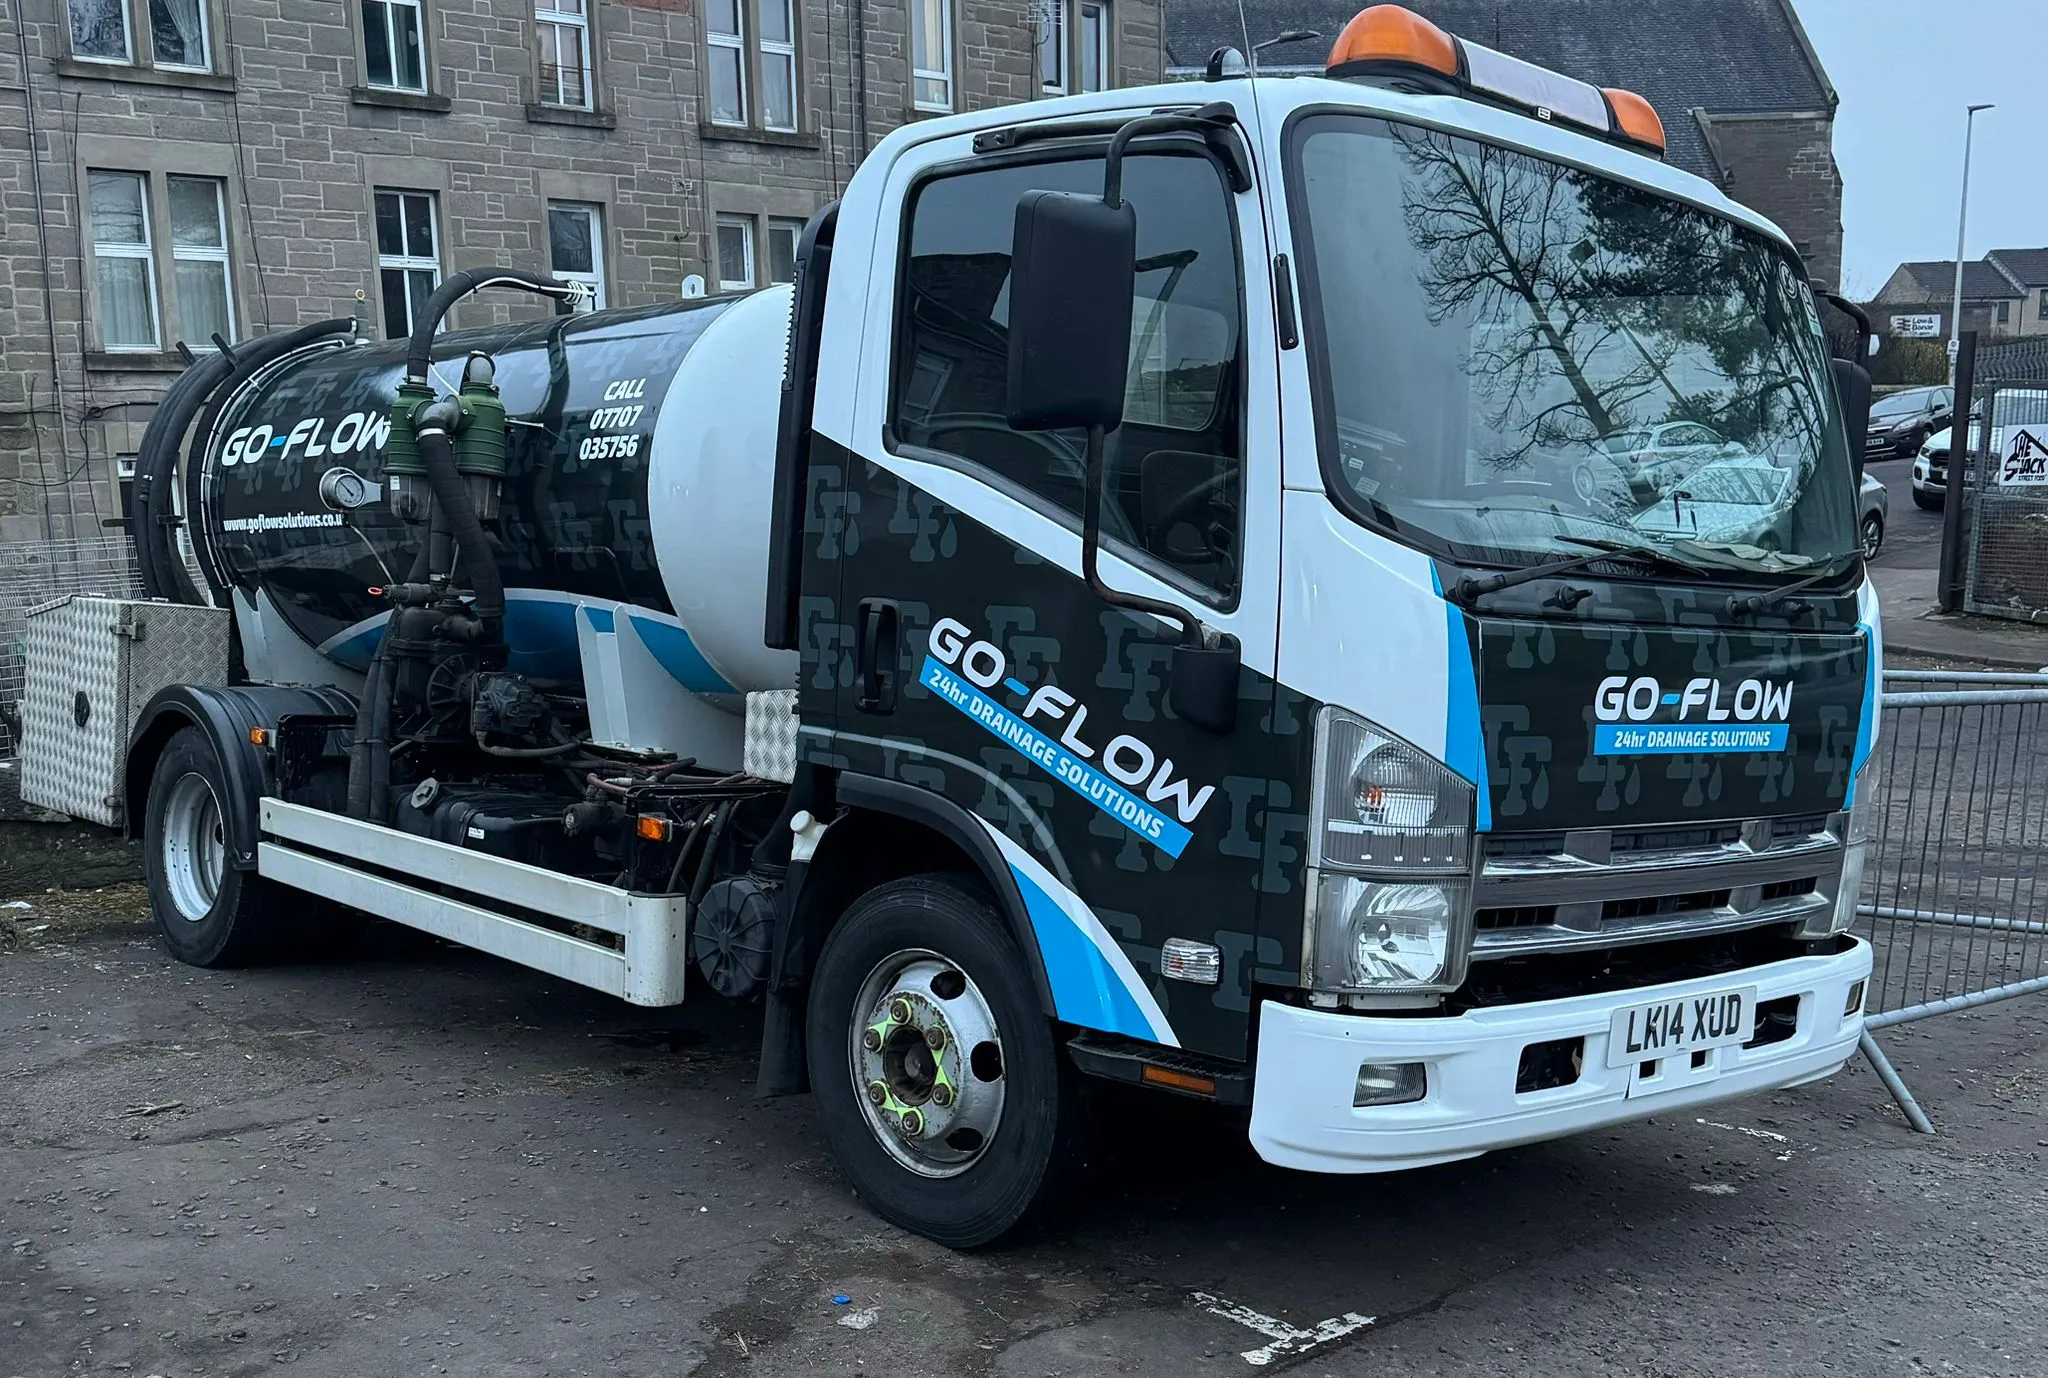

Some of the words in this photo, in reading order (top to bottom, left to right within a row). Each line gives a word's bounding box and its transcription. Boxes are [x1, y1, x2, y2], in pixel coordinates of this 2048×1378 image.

[604, 378, 646, 401] CALL
[589, 405, 644, 430] 07707
[221, 410, 391, 466] GO-FLOW
[579, 434, 640, 460] 035756
[223, 511, 343, 534] www.goflowsolutions.co.u
[1594, 676, 1794, 721] GO-FLOW
[928, 617, 1216, 823] GO-FLOW
[928, 669, 968, 706] 24hr
[968, 699, 1054, 768] DRAINAGE
[1056, 759, 1166, 839] SOLUTIONS
[1614, 732, 1646, 748] 24hr
[1647, 731, 1708, 748] DRAINAGE
[1710, 731, 1771, 747] SOLUTIONS
[1626, 1002, 1684, 1053] LK14
[1691, 994, 1742, 1042] XUD
